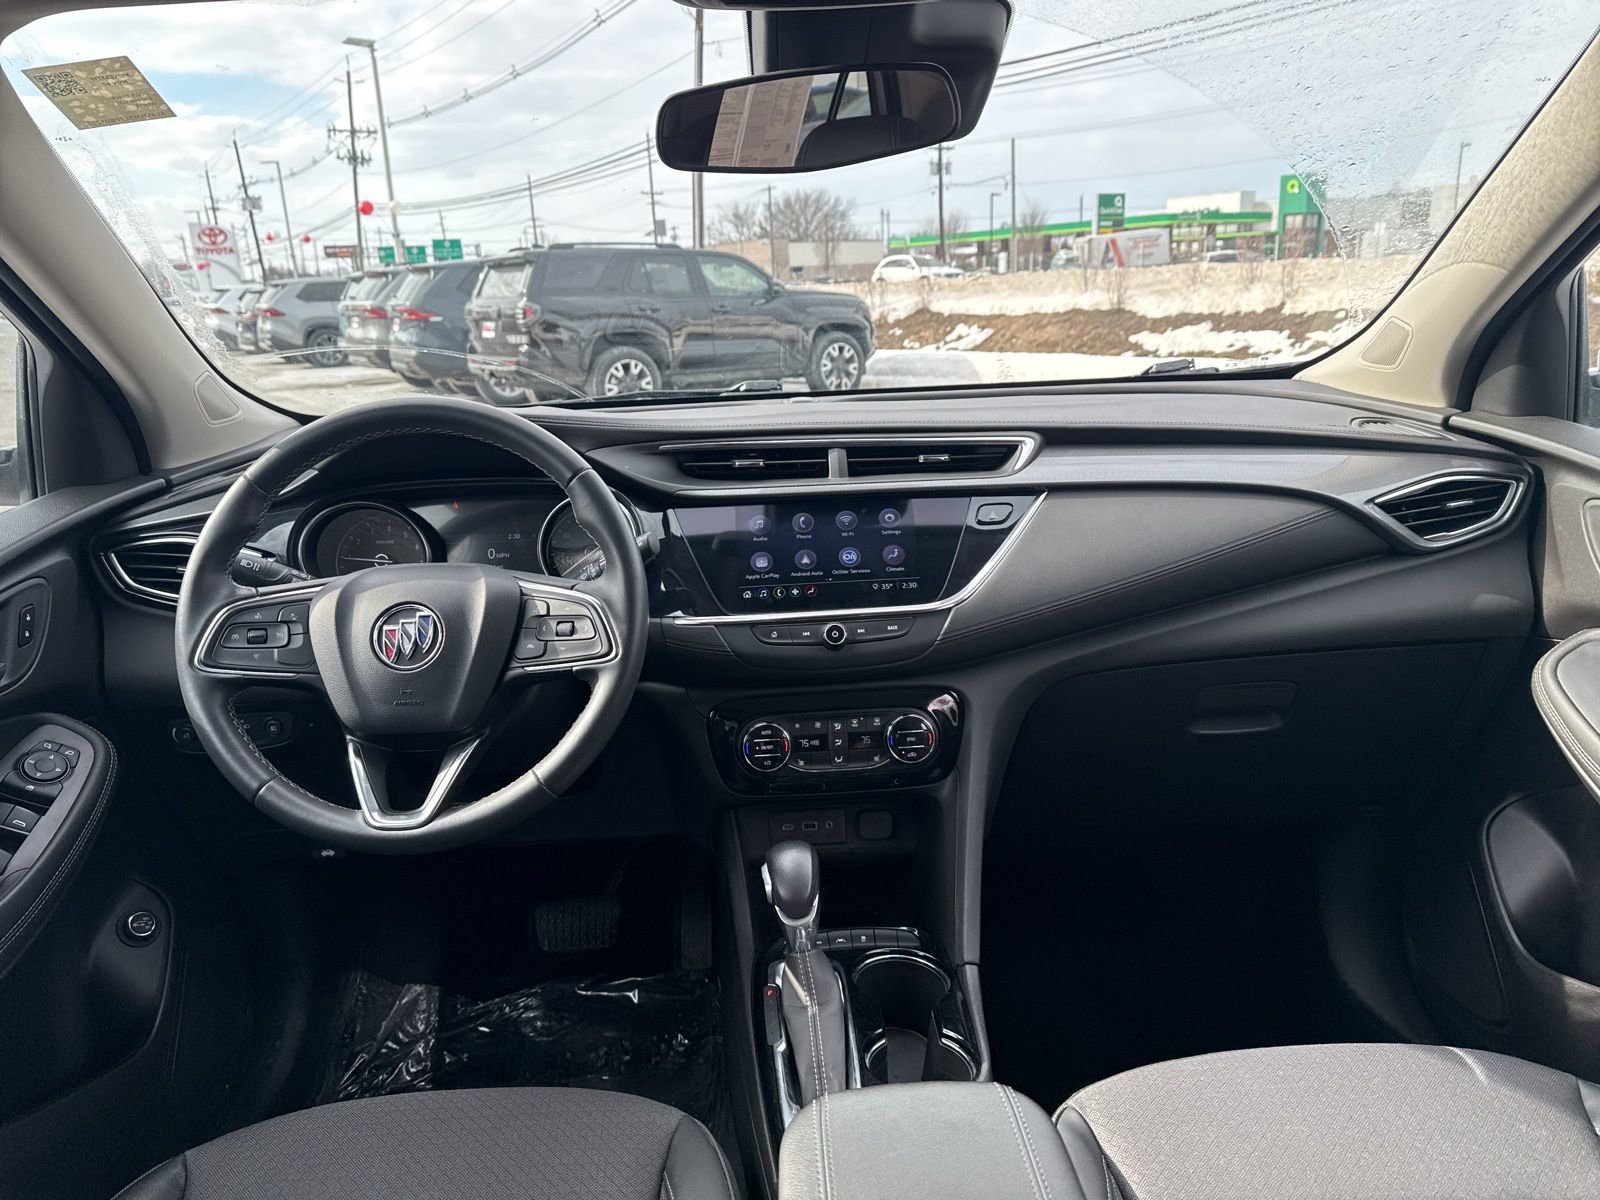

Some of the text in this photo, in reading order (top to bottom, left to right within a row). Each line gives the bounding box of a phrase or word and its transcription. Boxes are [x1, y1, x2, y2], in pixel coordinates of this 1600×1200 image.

[487, 548, 496, 560] 0
[902, 581, 918, 589] 2:30
[799, 739, 809, 748] 75
[860, 735, 871, 744] 75
